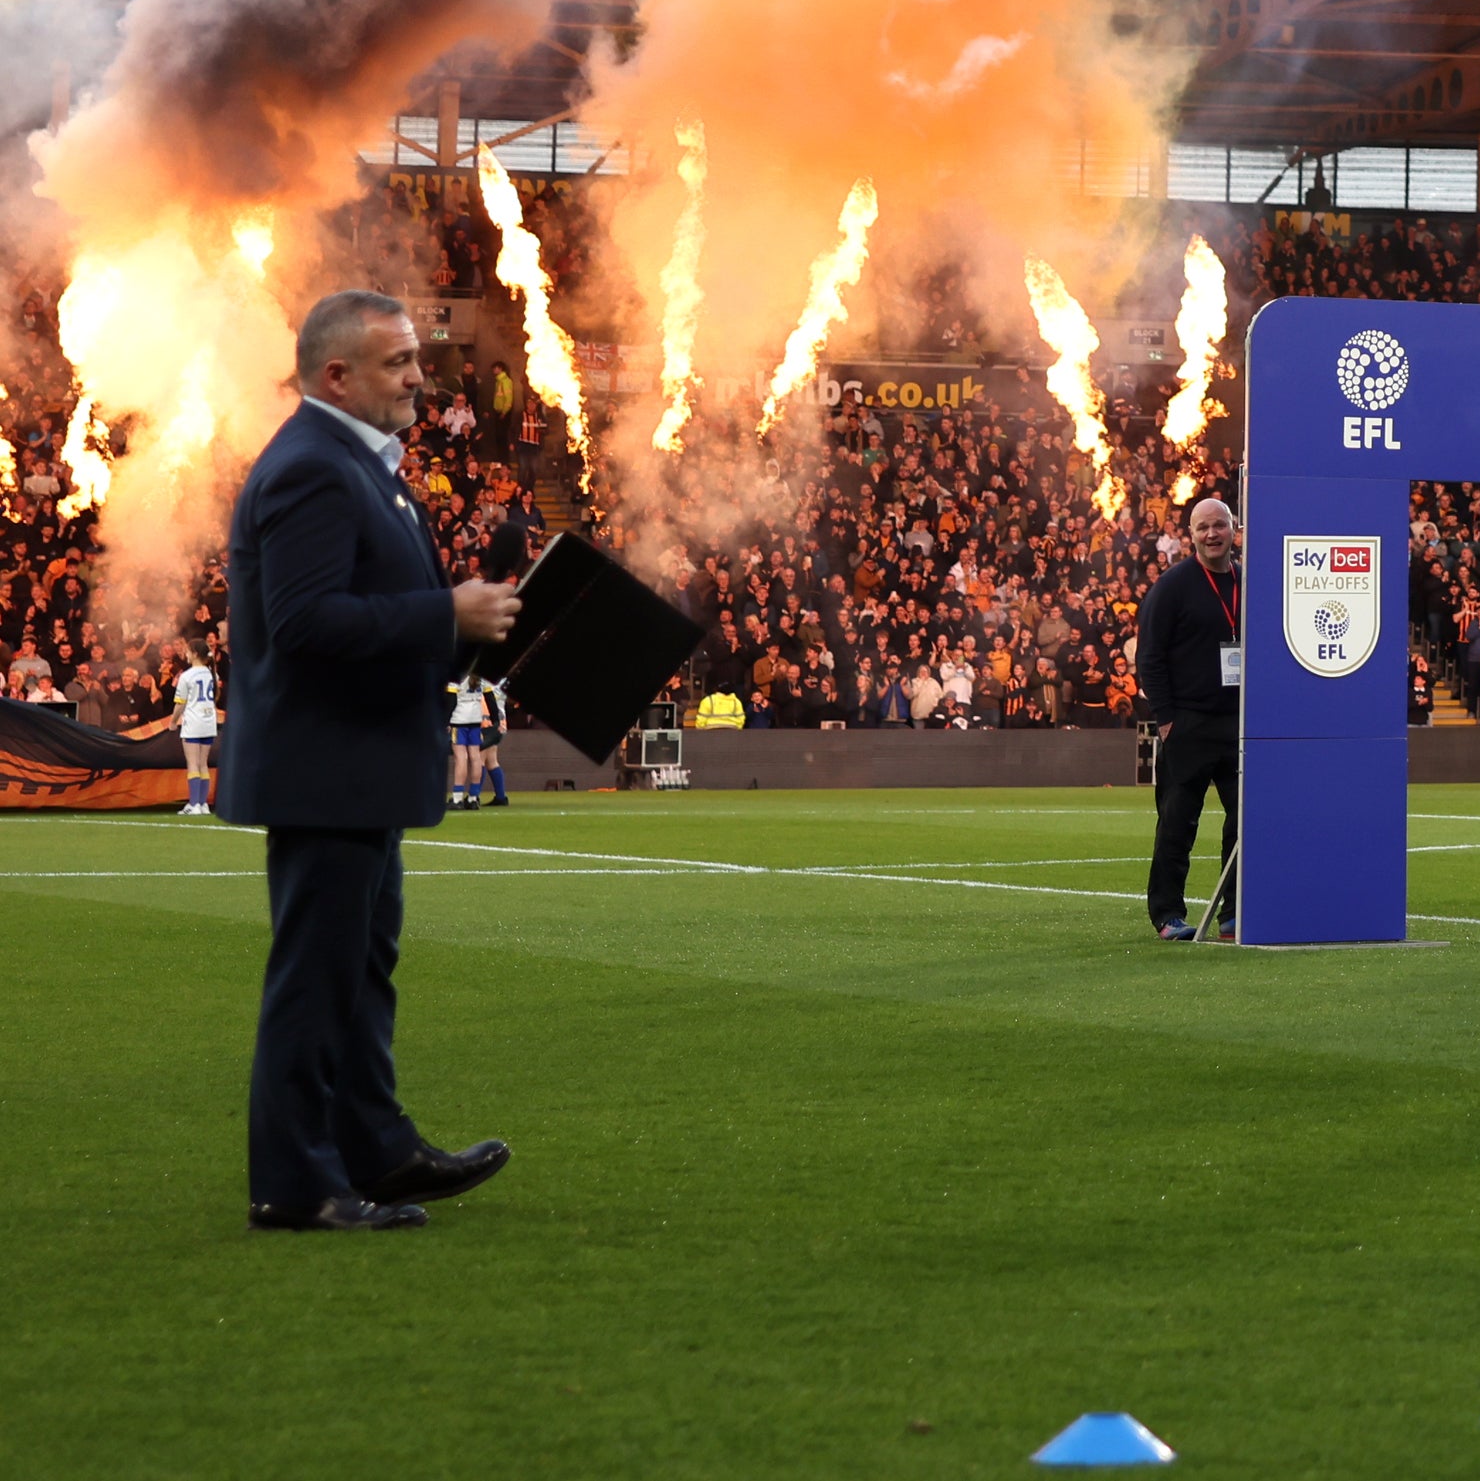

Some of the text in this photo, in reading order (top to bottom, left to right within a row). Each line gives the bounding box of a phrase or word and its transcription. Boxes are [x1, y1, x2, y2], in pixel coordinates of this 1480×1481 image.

[1343, 416, 1401, 450] EFL
[1293, 548, 1367, 571] sky bet
[1295, 576, 1370, 590] PLAY-OFFS
[1318, 643, 1347, 660] EFL
